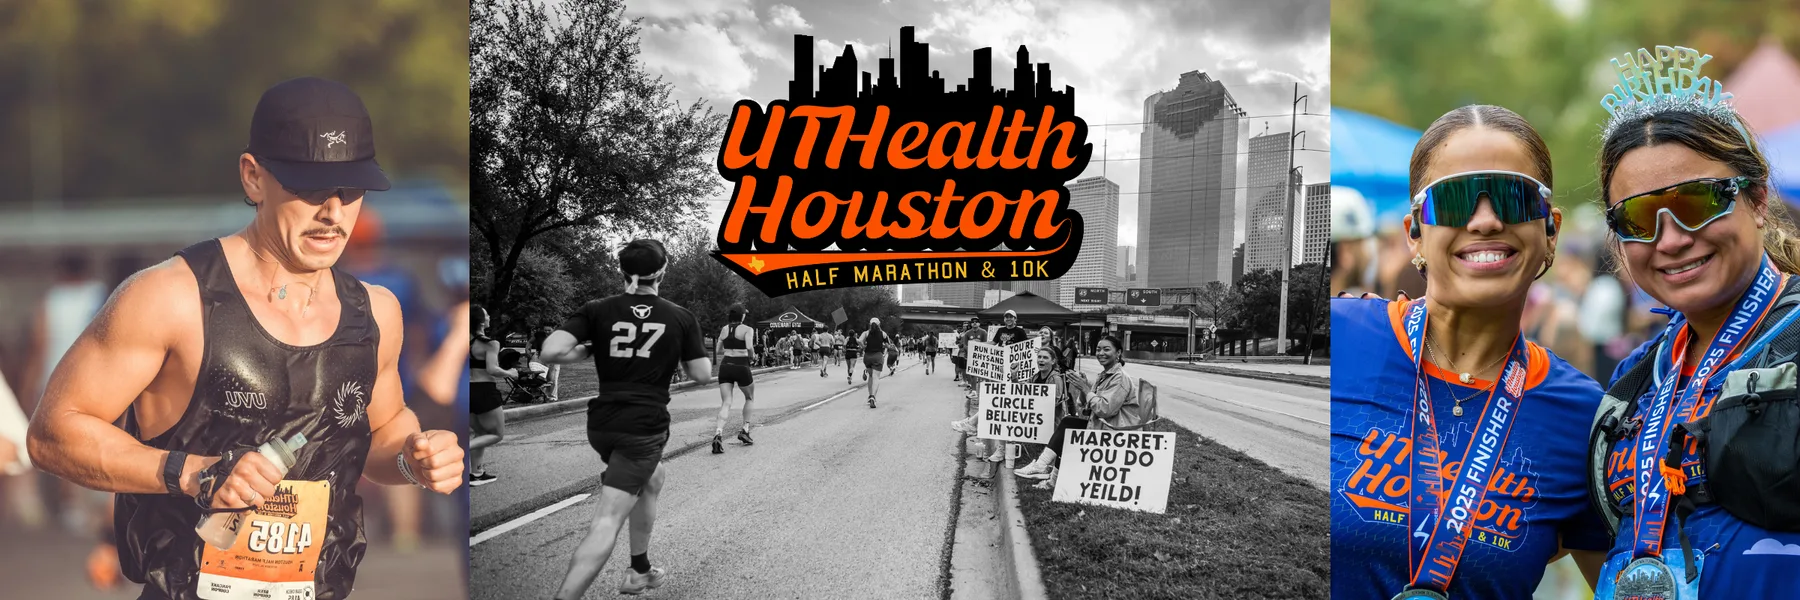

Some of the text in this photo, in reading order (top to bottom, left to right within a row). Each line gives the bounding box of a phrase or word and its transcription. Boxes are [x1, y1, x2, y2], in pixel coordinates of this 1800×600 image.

[1610, 45, 1713, 82] HAPPY
[1600, 67, 1735, 117] BIRTHDAY
[1692, 348, 1724, 389] 2025
[1719, 267, 1776, 344] FINISHER
[609, 321, 667, 359] 27
[1009, 341, 1035, 353] YOU'RE
[972, 353, 1004, 365] RHYSAND
[974, 345, 1004, 358] RUN LIKE
[1009, 350, 1032, 363] DOING
[967, 366, 989, 377] FINISH
[991, 364, 1004, 373] TH
[1007, 368, 1036, 382] SEETIE
[984, 383, 1049, 397] THE INNER
[991, 397, 1034, 410] CIRCLE
[1643, 371, 1677, 452] FINISHER
[986, 409, 1044, 425] BELIEVES
[989, 424, 1038, 440] IN YOU!
[1070, 430, 1168, 450] MARGRET:
[1080, 448, 1154, 467] YOU DO
[1446, 397, 1512, 534] 2025 FINISHER
[1089, 466, 1131, 484] NOT
[1080, 482, 1141, 505] YEILD!
[1374, 510, 1405, 524] HALF
[1478, 532, 1487, 543] &
[1492, 537, 1512, 550] 10K
